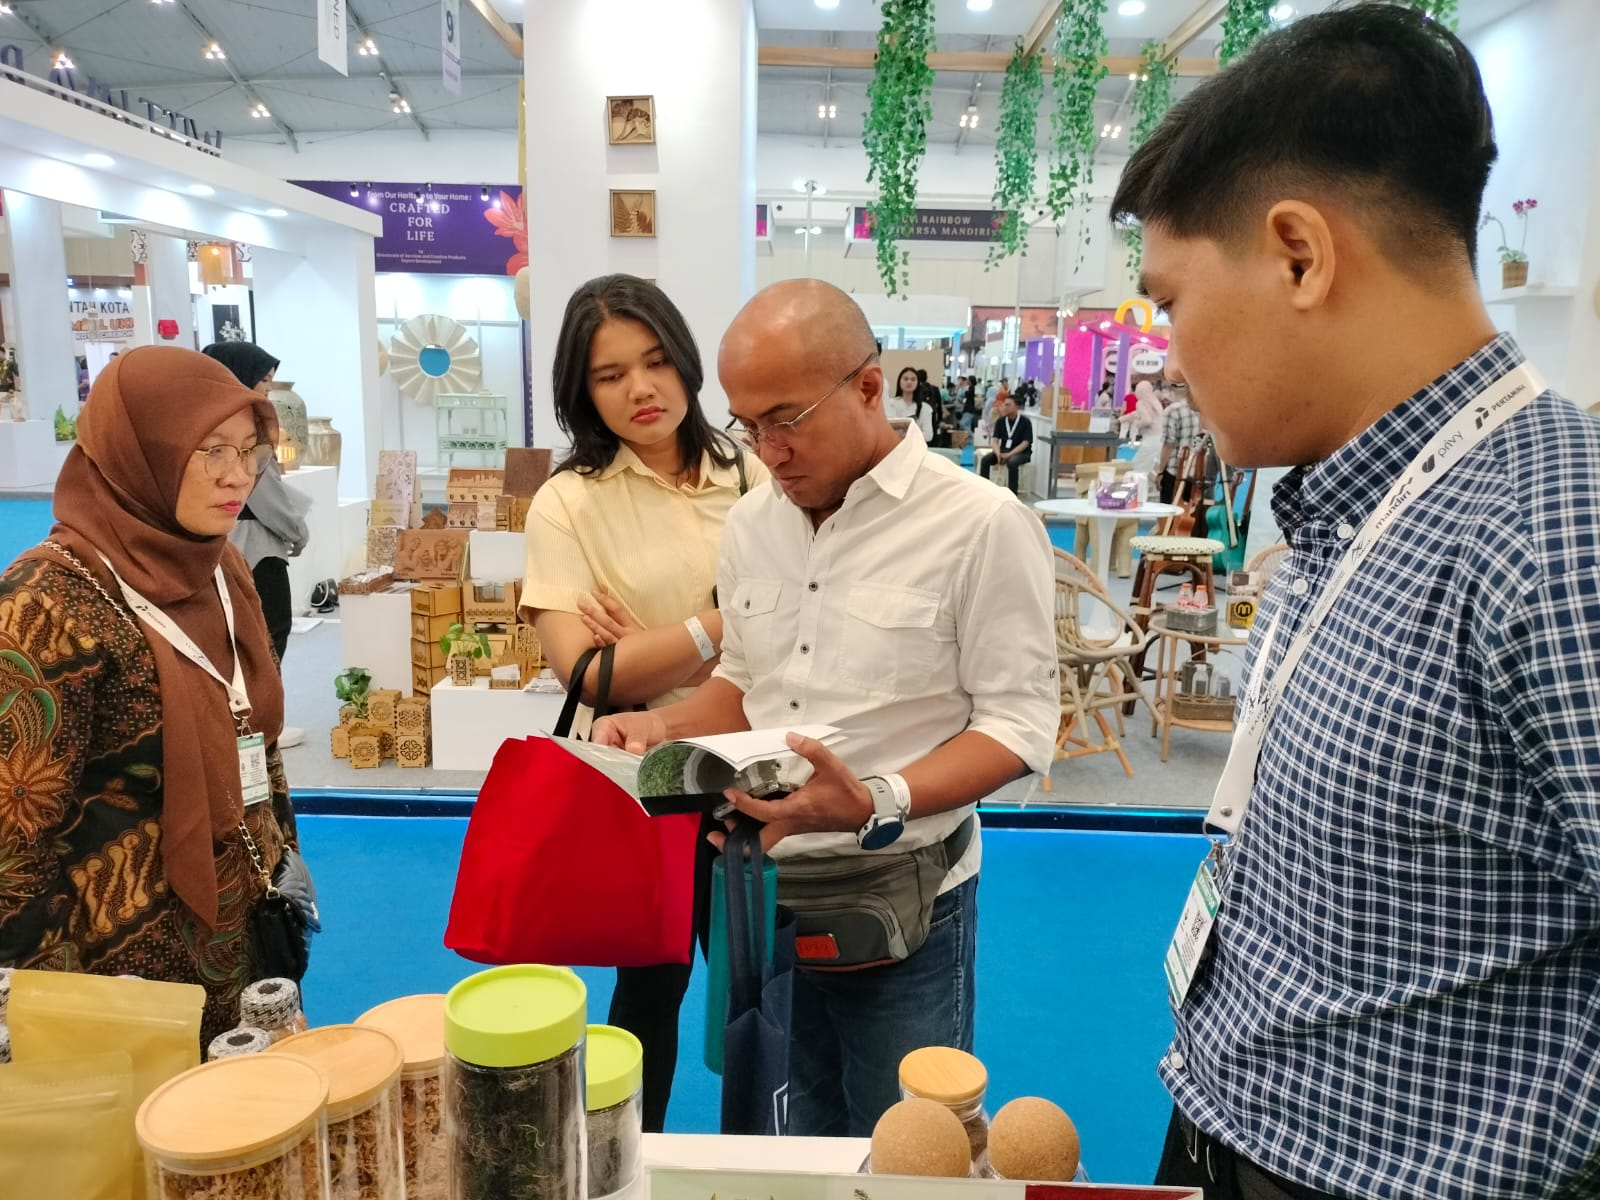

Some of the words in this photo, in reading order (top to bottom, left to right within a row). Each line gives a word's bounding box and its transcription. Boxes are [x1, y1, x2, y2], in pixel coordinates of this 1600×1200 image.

[446, 10, 454, 43] 9
[367, 190, 384, 199] From
[385, 191, 397, 199] Our
[397, 191, 425, 200] Heritae
[426, 192, 433, 200] to
[449, 193, 469, 201] Home
[389, 202, 450, 214] CRAFTED
[407, 216, 433, 227] FOR
[922, 215, 971, 225] RAINBOW
[406, 230, 435, 241] LIFE
[941, 226, 991, 236] MANDIRI
[100, 301, 130, 314] KOTA
[1491, 384, 1526, 412] PERTAMINA
[1437, 431, 1464, 458] privy
[1375, 490, 1412, 529] mandiri
